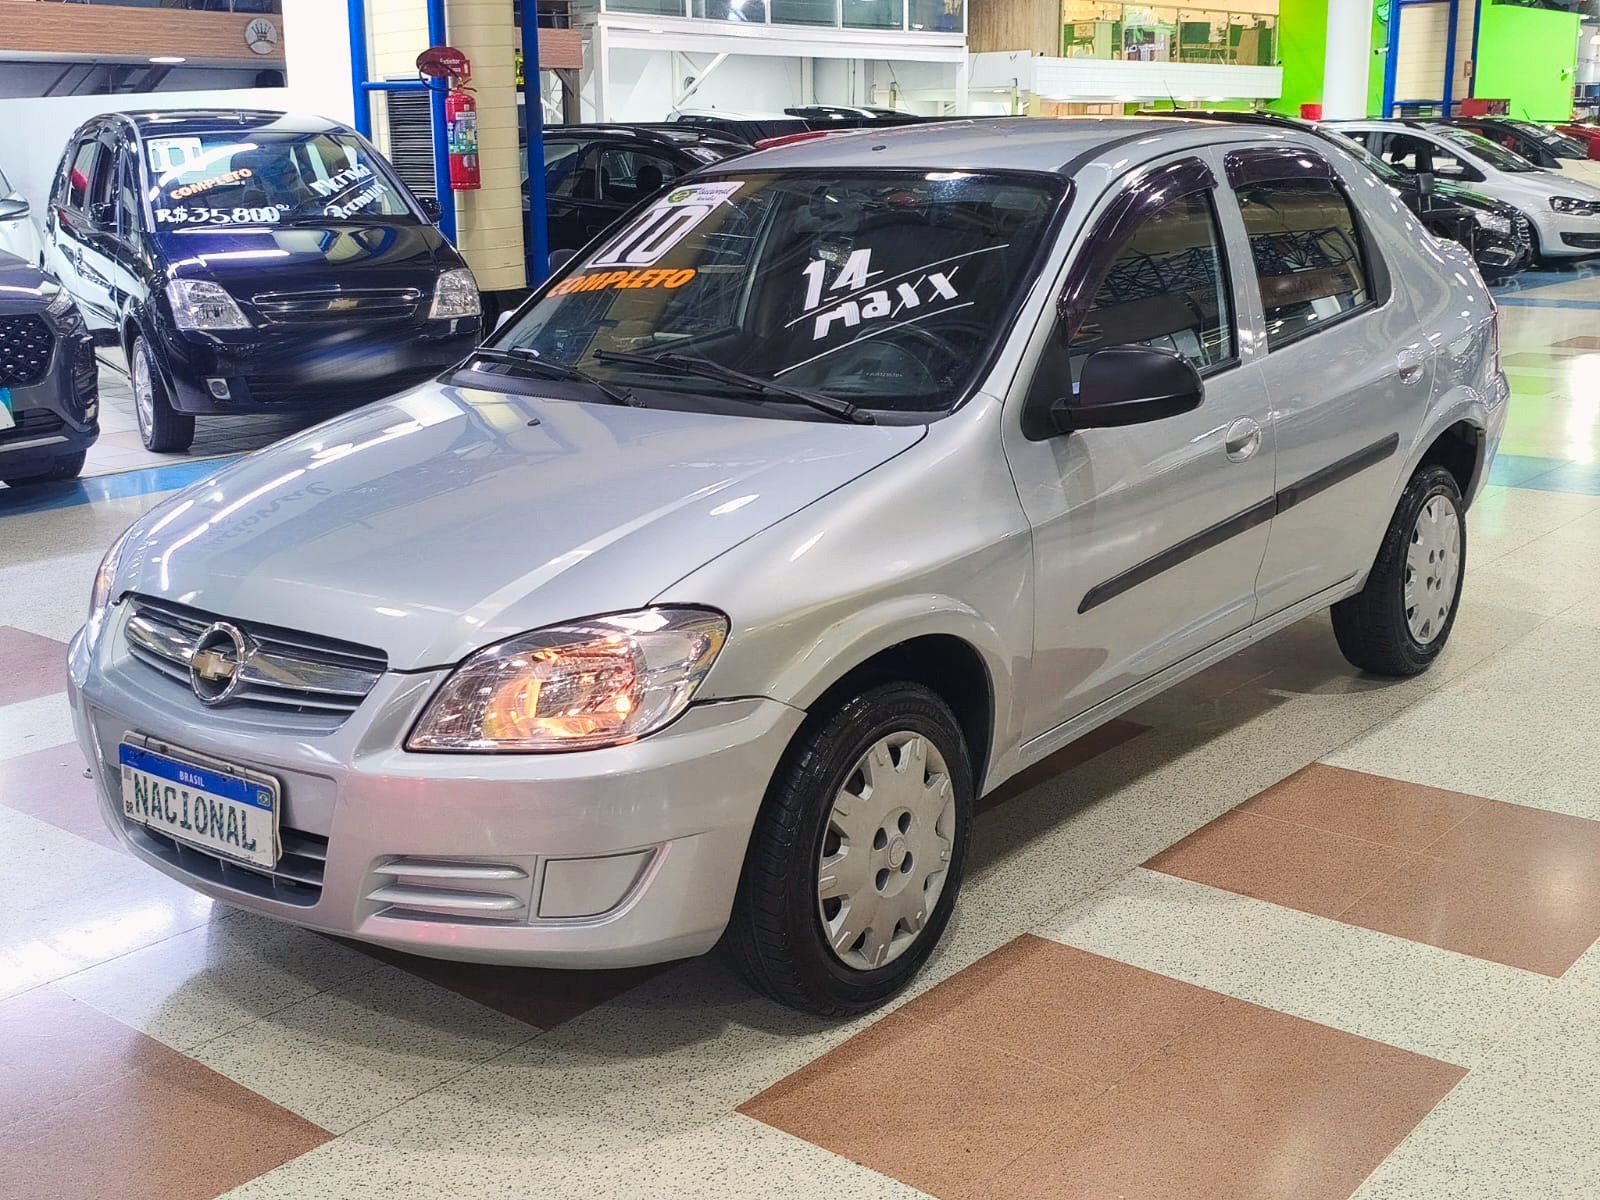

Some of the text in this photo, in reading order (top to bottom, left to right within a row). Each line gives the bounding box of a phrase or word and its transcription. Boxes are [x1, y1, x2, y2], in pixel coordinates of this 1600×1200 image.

[170, 168, 253, 199] COMPLETO
[592, 204, 714, 265] 10
[546, 268, 697, 298] COMPLETO
[179, 770, 205, 787] BRASIL
[125, 800, 134, 814] BR
[134, 773, 257, 852] NACIONAL
